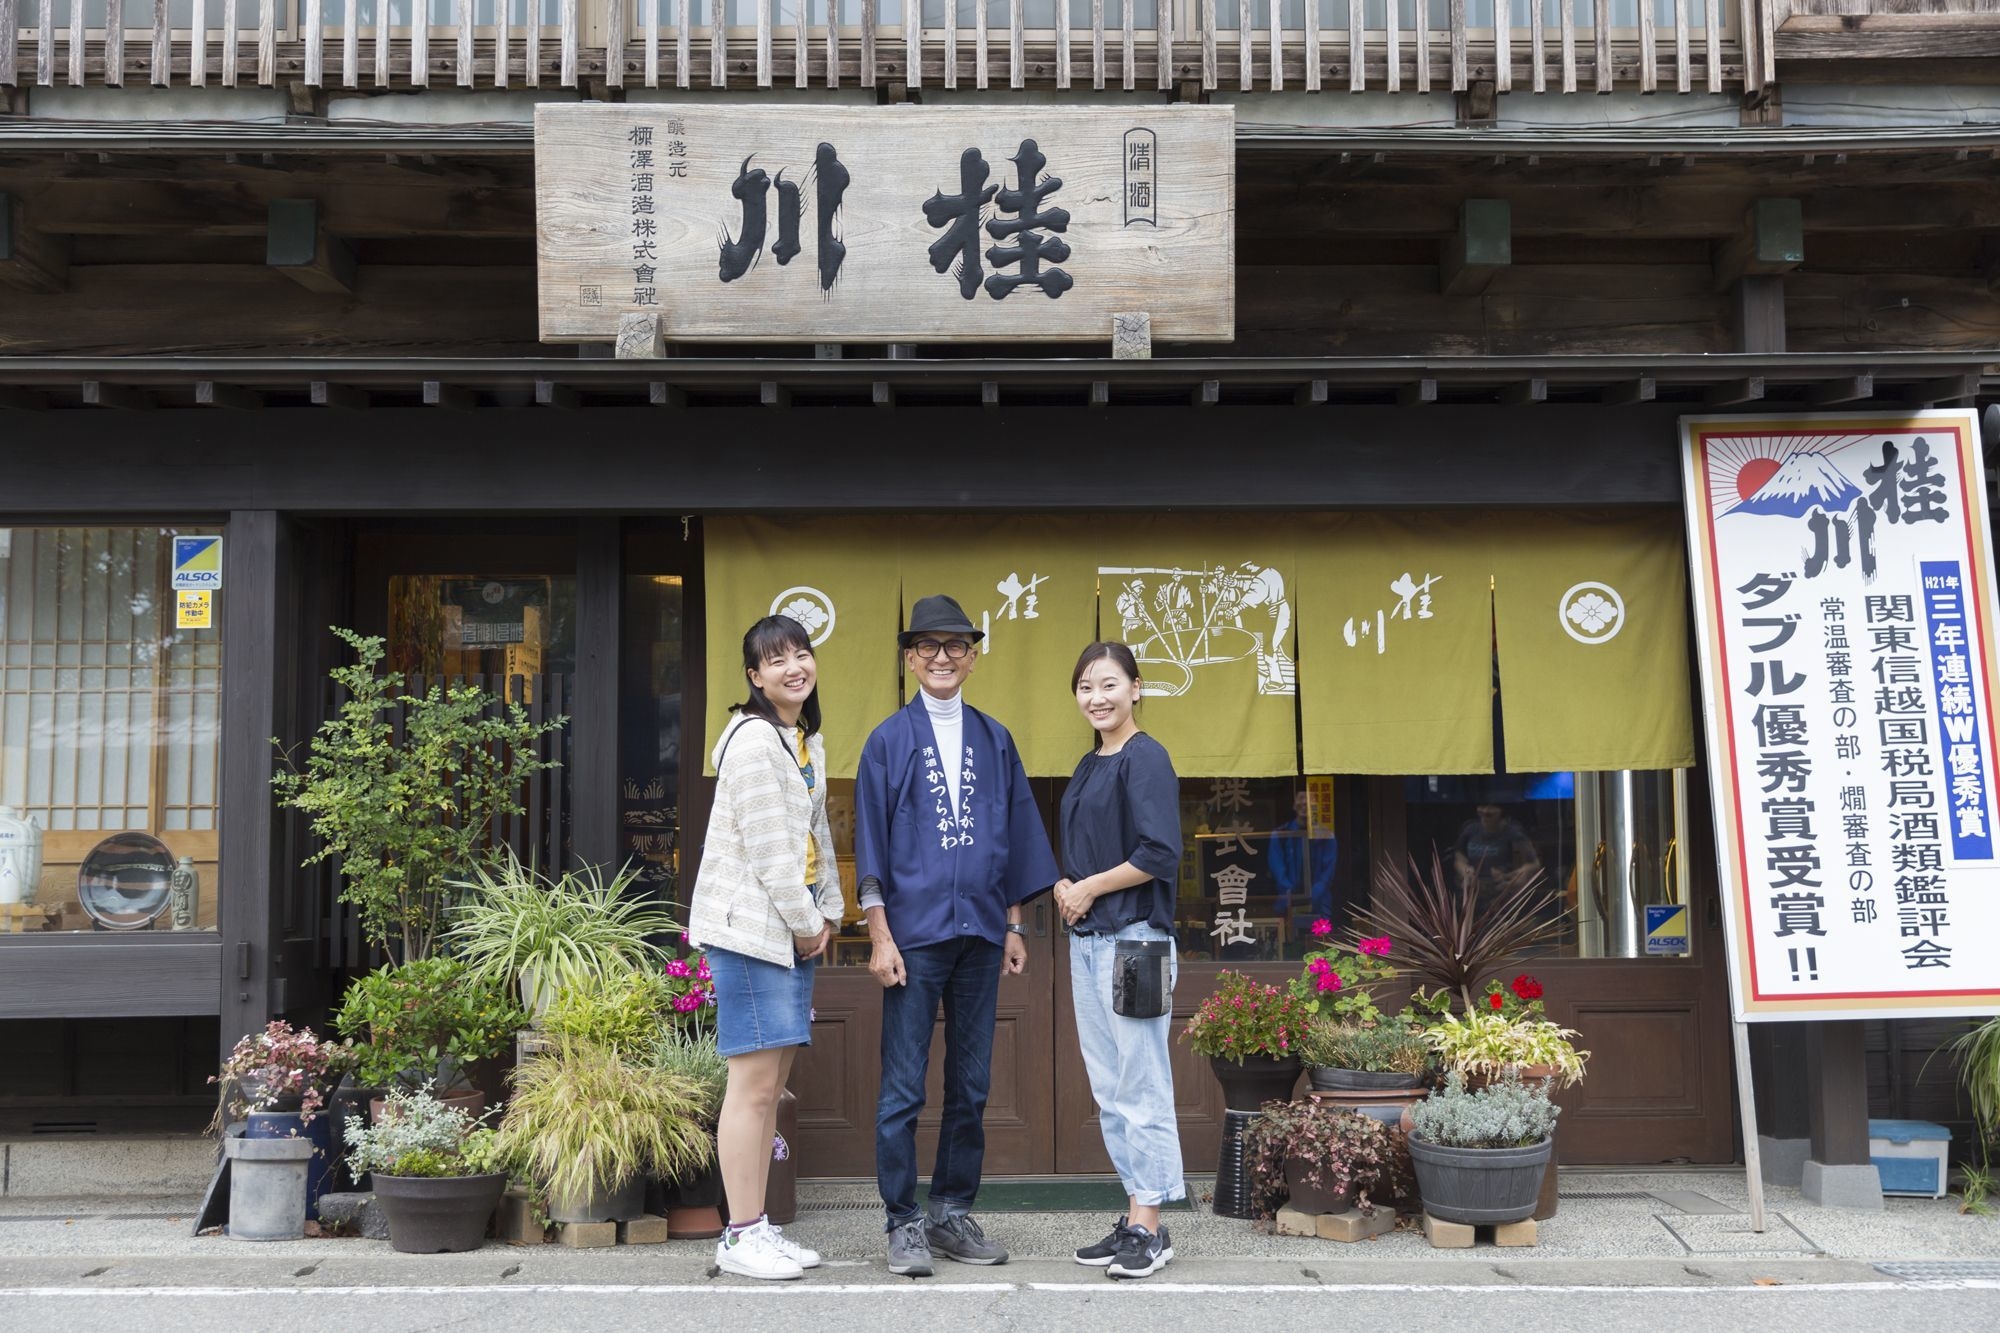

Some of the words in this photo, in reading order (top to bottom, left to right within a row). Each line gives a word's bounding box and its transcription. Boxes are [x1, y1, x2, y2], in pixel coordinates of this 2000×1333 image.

[1129, 142, 1151, 208] 清酒
[176, 572, 219, 582] ALSOK
[179, 601, 210, 609] 防犯カメラ
[1924, 575, 1960, 590] H21年
[1931, 593, 1987, 839] 三年連続W優秀賞
[926, 769, 958, 851] かつらがわ
[959, 768, 977, 846] かつらがわ
[1864, 594, 1953, 970] 関東信越国税局酒類鑑評会
[1647, 937, 1687, 946] ALSOK
